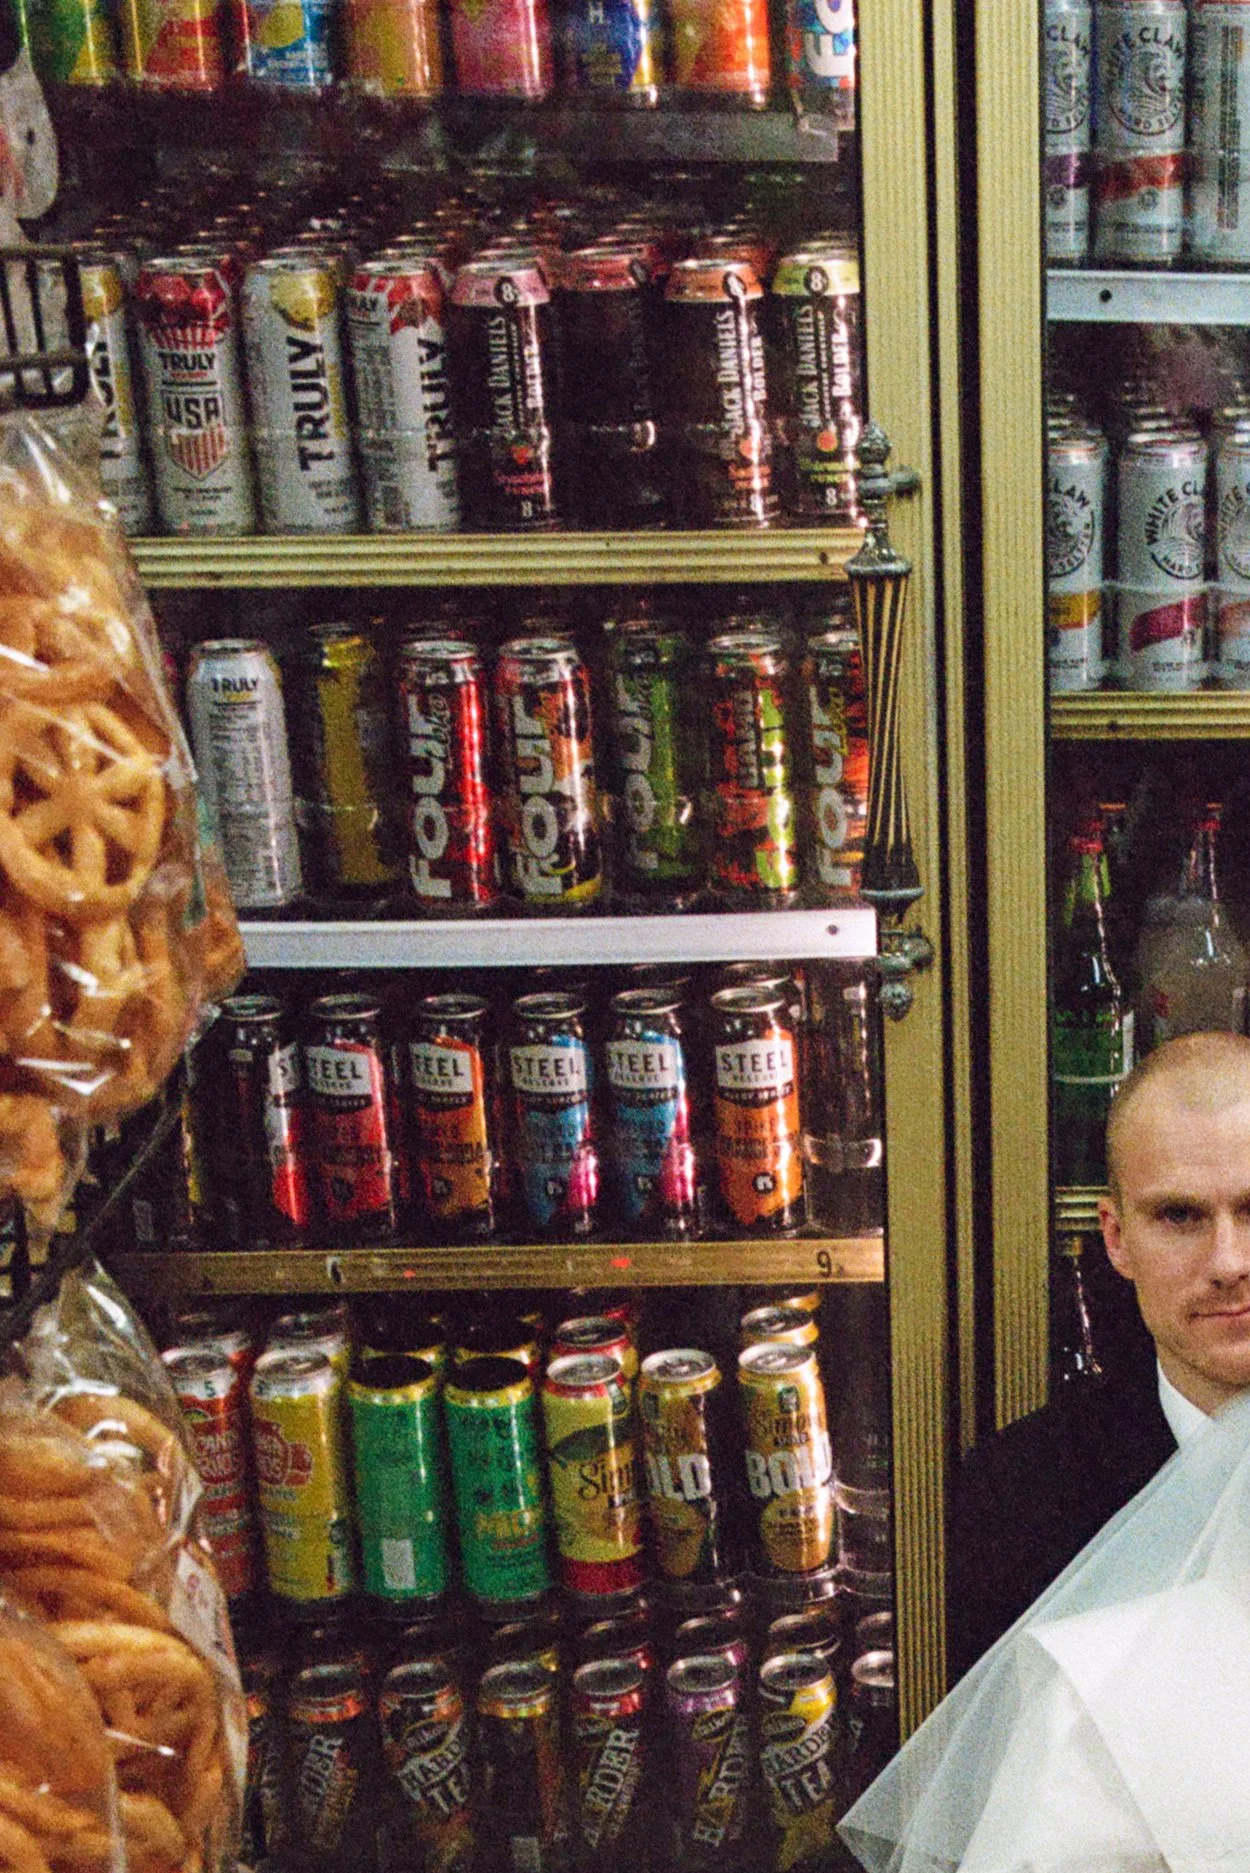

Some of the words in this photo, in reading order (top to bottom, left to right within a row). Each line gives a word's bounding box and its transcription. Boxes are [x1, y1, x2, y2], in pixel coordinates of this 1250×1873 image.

[159, 351, 216, 371] TRULY
[750, 335, 768, 402] BOLDER
[830, 329, 852, 398] BOLDER
[167, 397, 222, 429] USA
[286, 334, 335, 472] TRULY
[416, 336, 455, 472] TRULY
[492, 394, 516, 438] JACK
[721, 386, 744, 436] JACK
[1053, 479, 1090, 508] LAW
[1144, 487, 1180, 547] WHITE
[210, 676, 259, 693] TRULY
[513, 1056, 580, 1078] STEEL
[721, 1050, 788, 1073] STEEL
